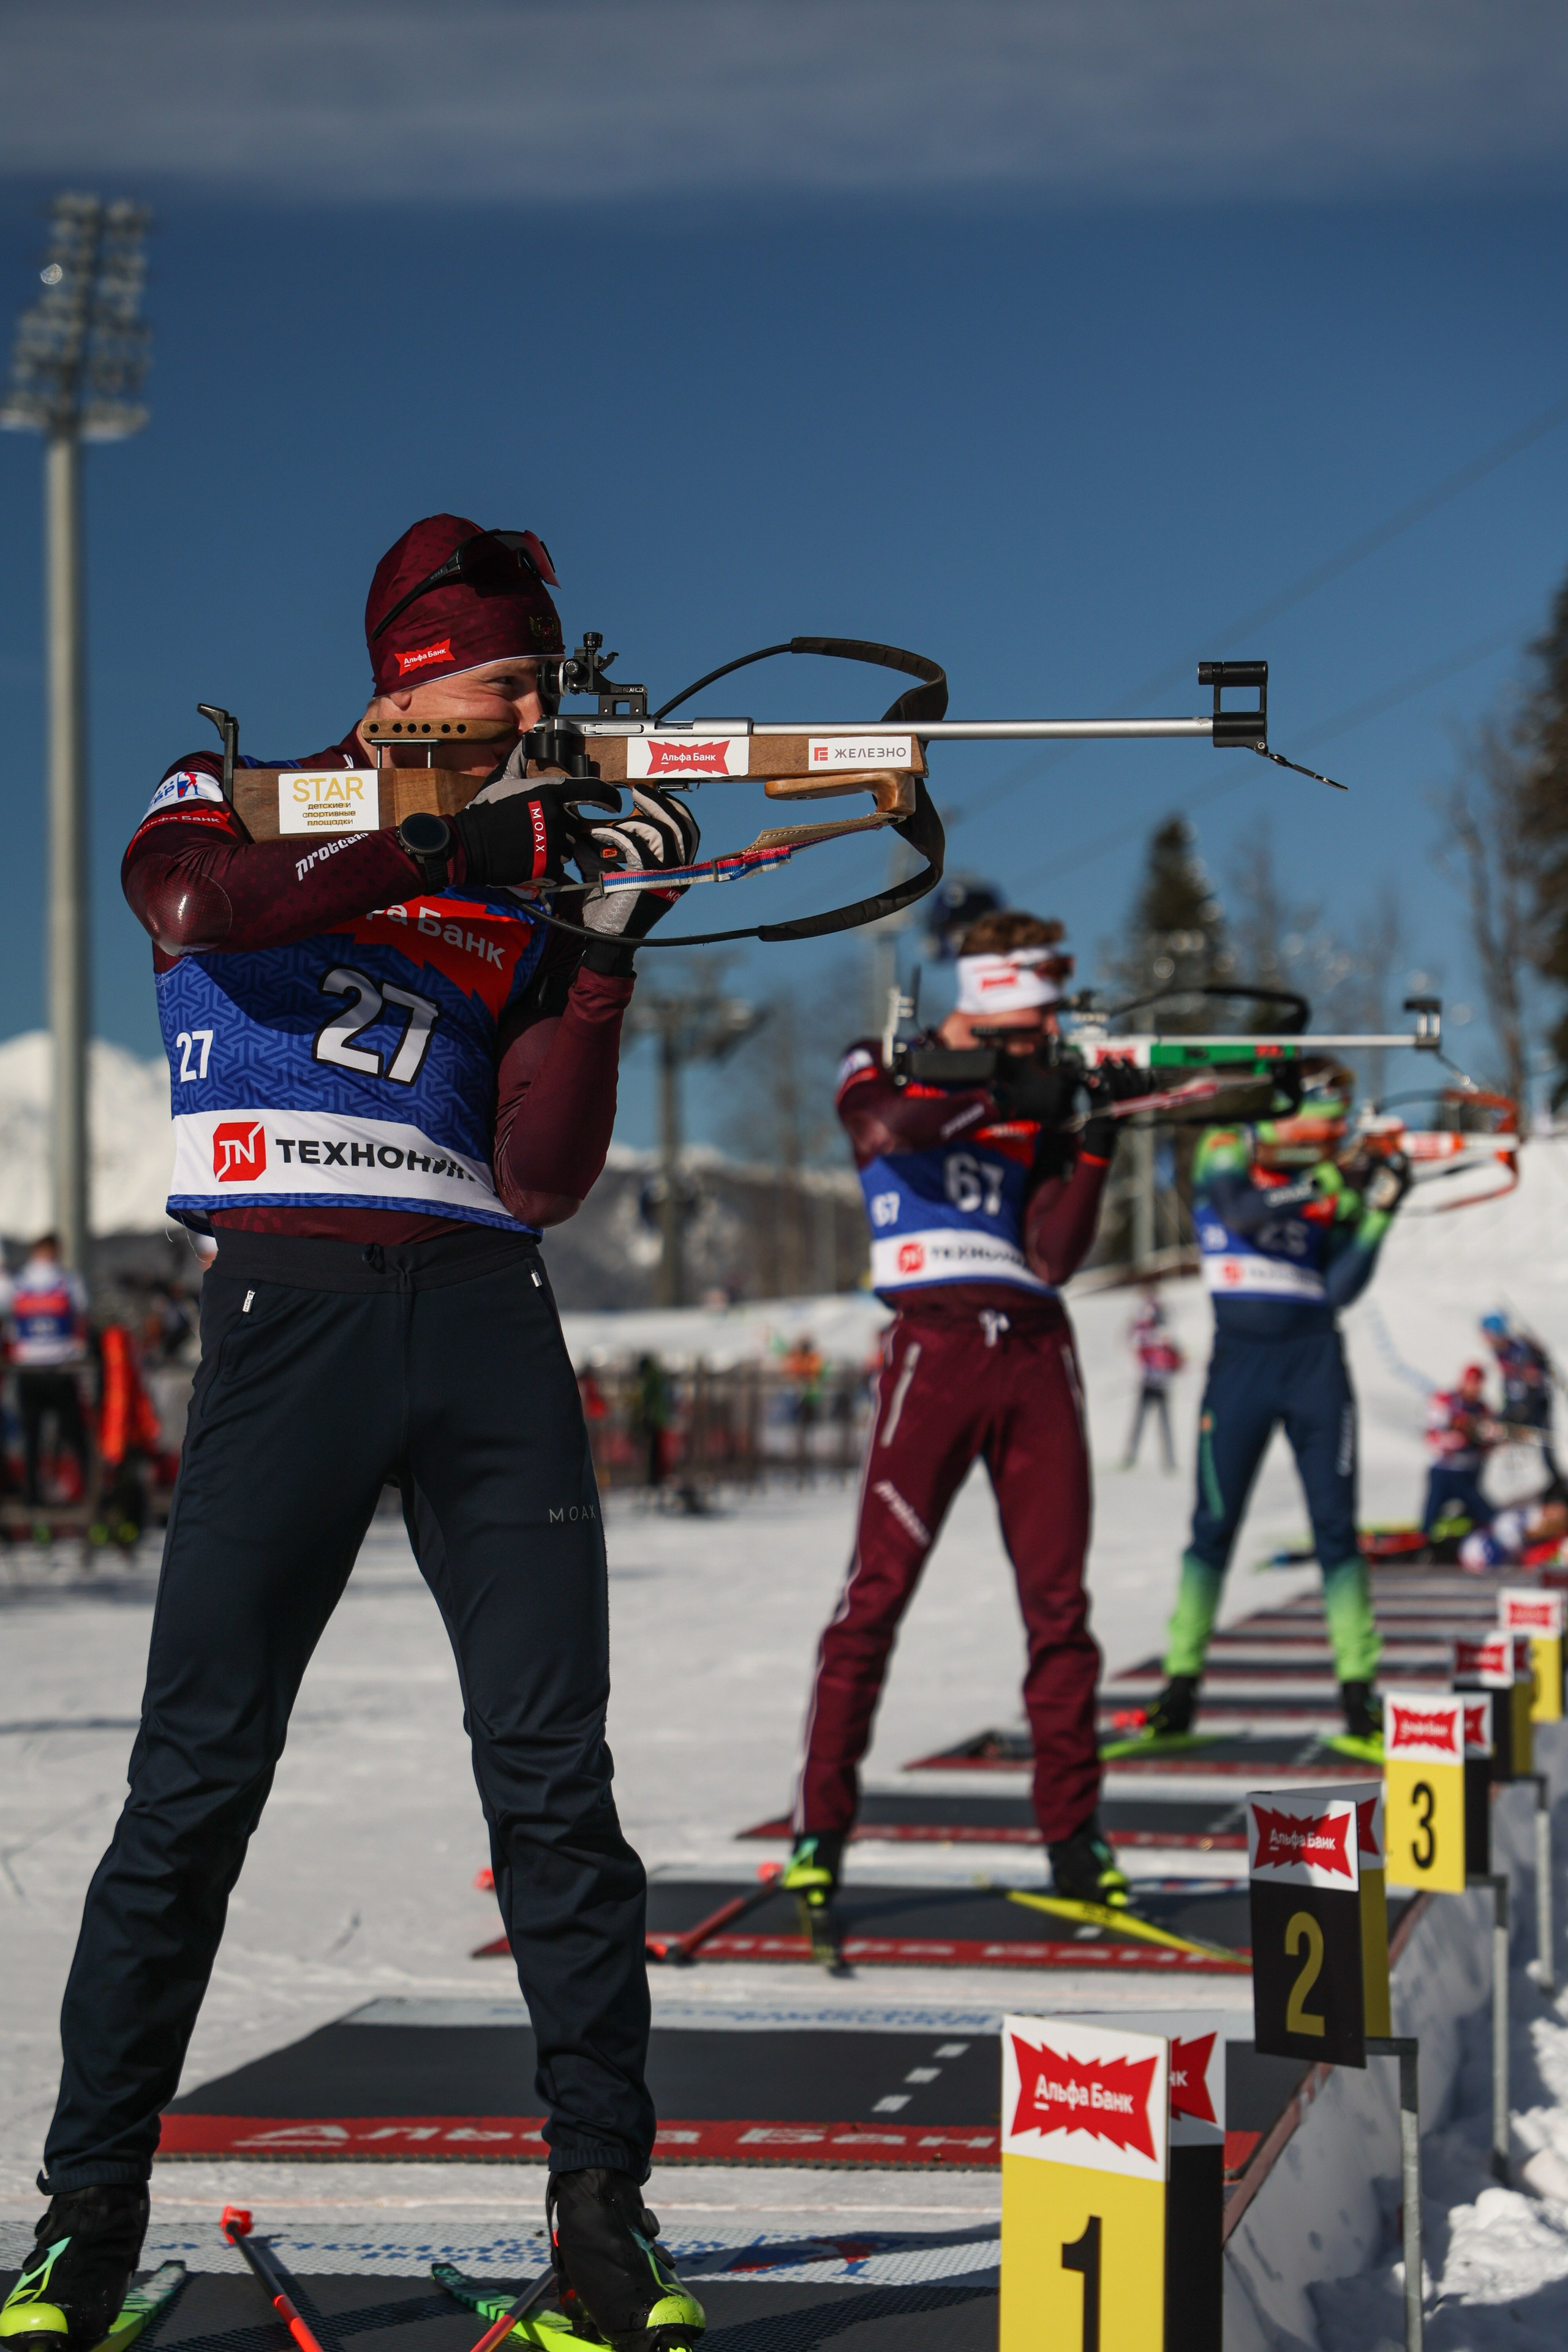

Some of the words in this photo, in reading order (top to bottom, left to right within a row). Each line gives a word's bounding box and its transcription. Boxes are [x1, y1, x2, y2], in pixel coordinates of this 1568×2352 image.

[404, 653, 428, 667] Альфа
[428, 649, 446, 658] Банк
[661, 752, 692, 764] Альфа
[693, 752, 716, 761] Банк
[834, 747, 907, 758] ЖЕЛЕЗНО
[293, 777, 364, 802] STAR
[181, 815, 221, 824] Банк
[303, 810, 356, 819] спортивные
[531, 807, 545, 853] MOAX
[666, 890, 680, 901] MO
[417, 906, 506, 971] Банк
[314, 965, 440, 1086] 27
[176, 1030, 214, 1083] 27
[944, 1152, 1005, 1217] 67
[549, 1505, 595, 1523] MOAX
[1411, 1781, 1435, 1869] 3
[1269, 1828, 1306, 1850] Альфа
[1306, 1833, 1336, 1850] Банк
[1284, 1911, 1325, 2037] 2
[1034, 2074, 1090, 2111] Альфа
[1091, 2082, 1134, 2115] Банк
[737, 2127, 997, 2149] Бан
[1061, 2214, 1102, 2352] 1
